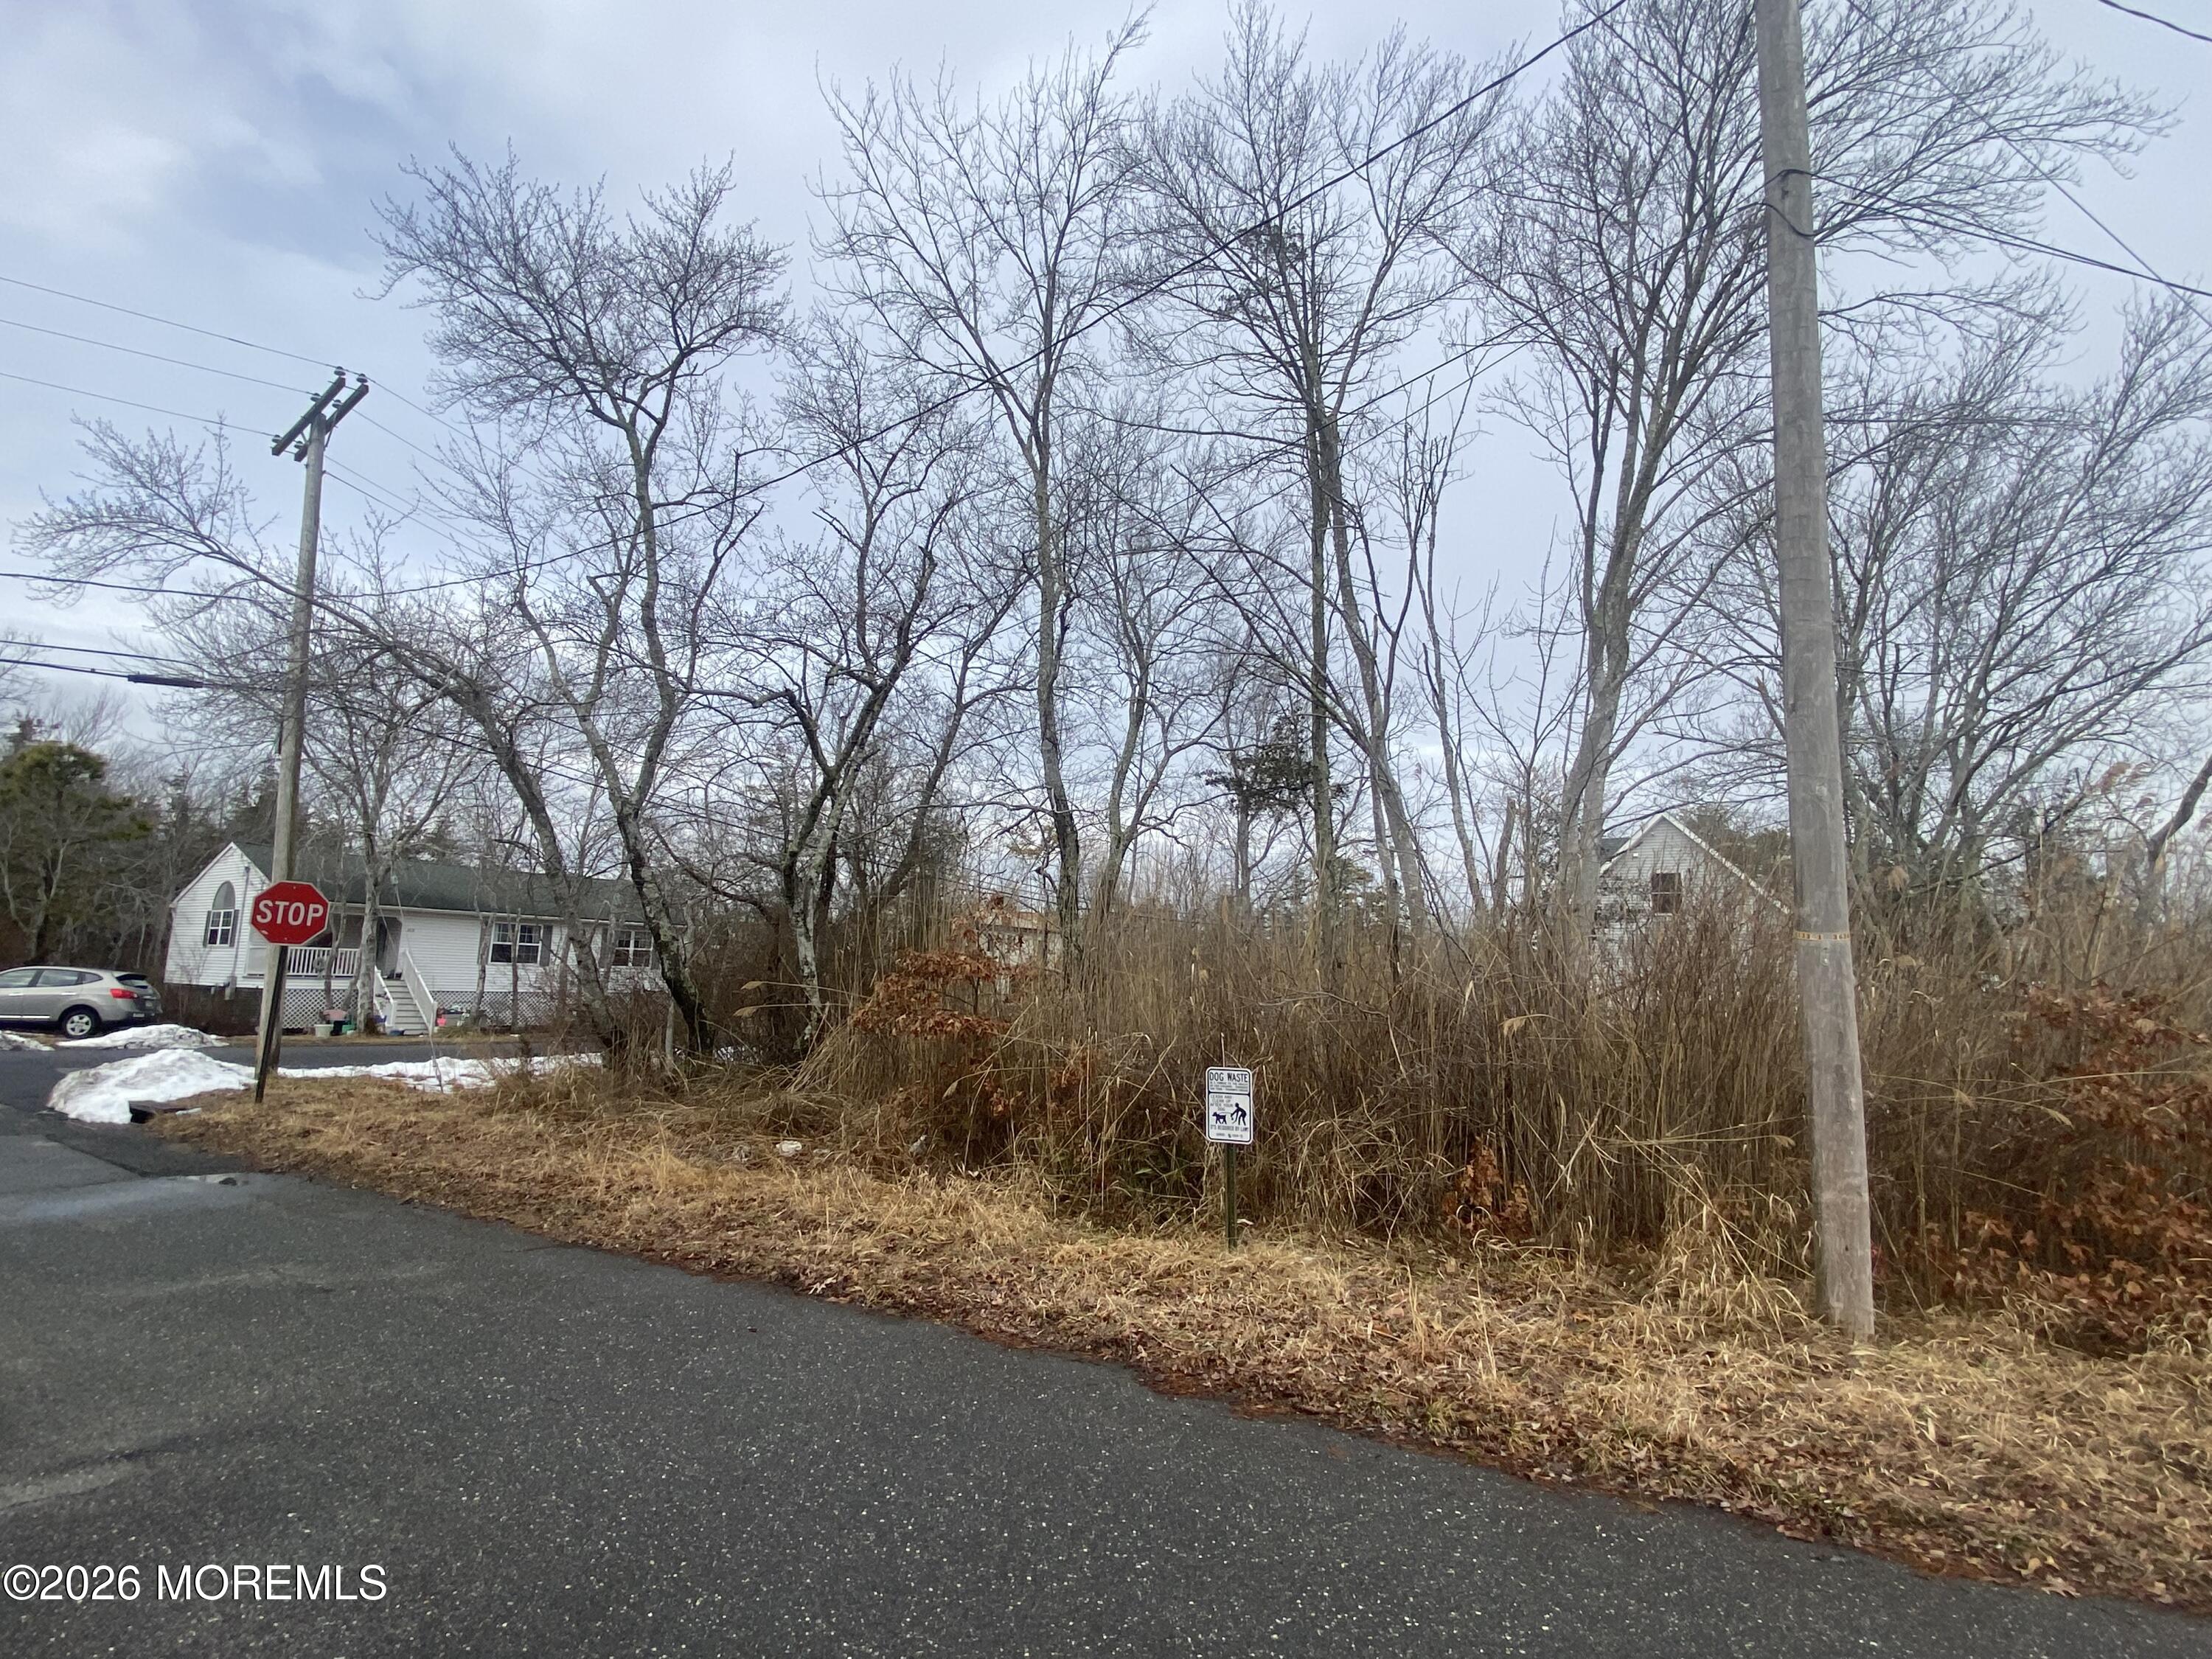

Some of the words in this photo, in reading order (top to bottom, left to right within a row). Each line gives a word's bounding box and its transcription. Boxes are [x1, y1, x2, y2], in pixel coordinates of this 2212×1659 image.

[256, 900, 324, 927] STOP
[1209, 1072, 1224, 1082] DOG
[1227, 1072, 1248, 1083] WASTE
